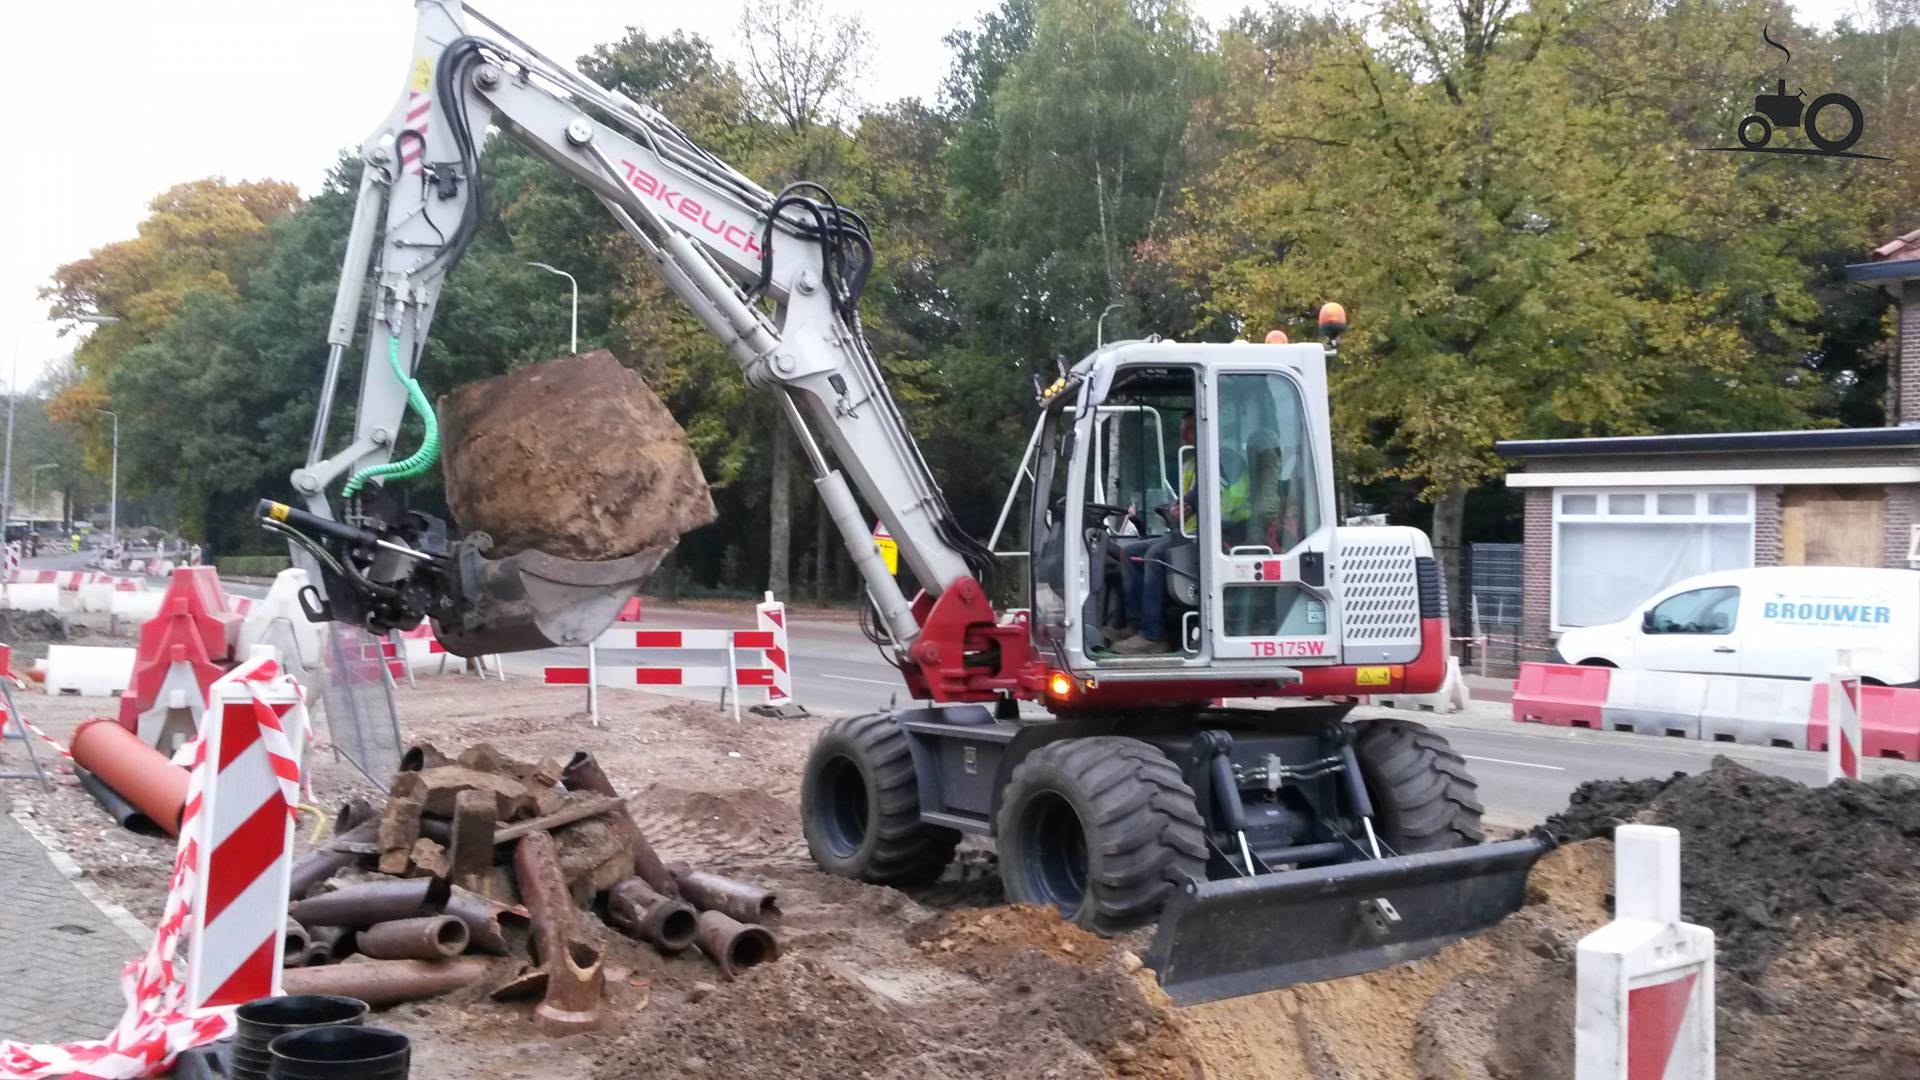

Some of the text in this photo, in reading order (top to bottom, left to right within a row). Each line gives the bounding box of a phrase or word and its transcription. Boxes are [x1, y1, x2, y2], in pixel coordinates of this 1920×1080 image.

[621, 159, 768, 262] TAKEUCH
[1764, 602, 1891, 623] BROUWER
[1250, 641, 1325, 657] TB175W
